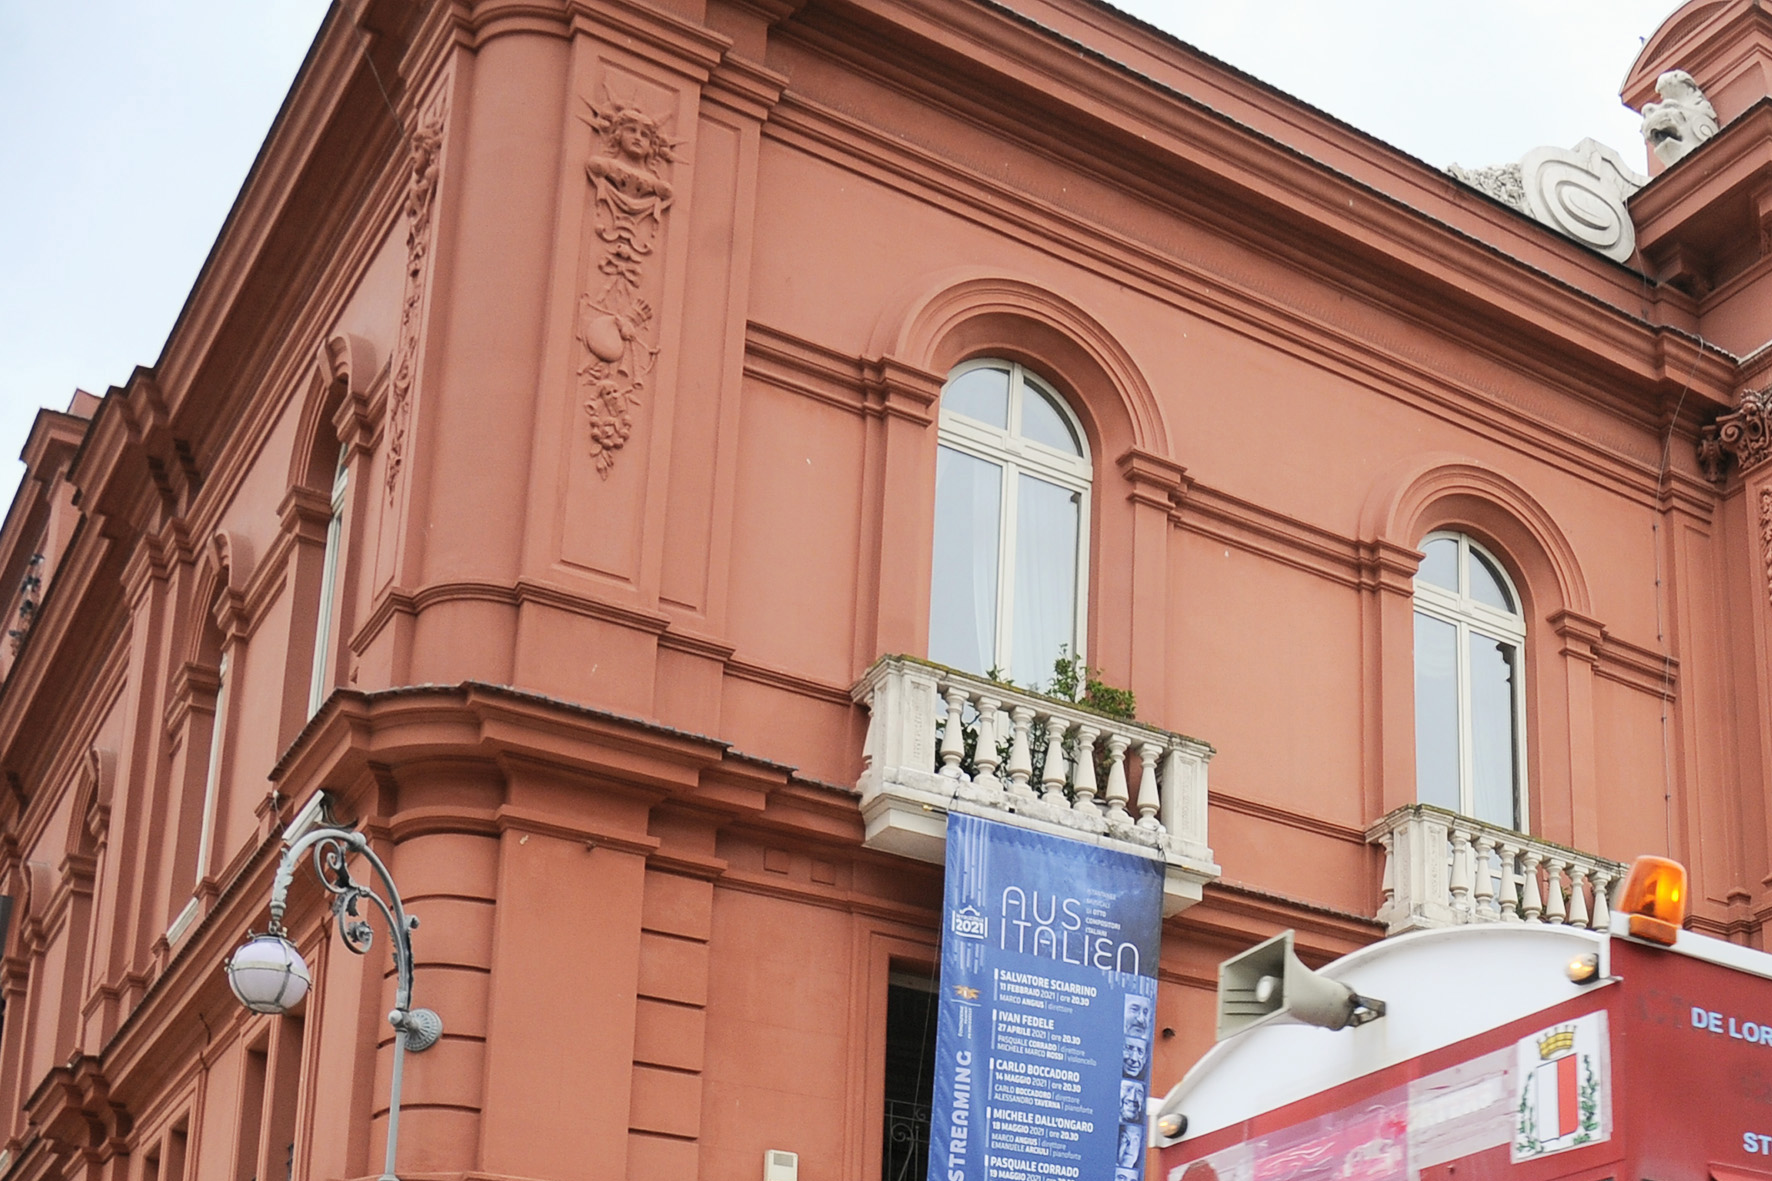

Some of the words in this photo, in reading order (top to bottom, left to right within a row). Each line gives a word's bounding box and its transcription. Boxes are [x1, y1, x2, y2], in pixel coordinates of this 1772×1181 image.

[1002, 886, 1081, 930] AUS
[956, 920, 984, 934] 2021
[1001, 918, 1139, 976] ITALIEN
[1001, 970, 1050, 988] SALVATORE
[1051, 980, 1096, 997] SCIARRINO
[1000, 994, 1021, 1004] MARCO
[1007, 984, 1040, 996] FEBBRAIO
[1041, 989, 1055, 999] 2021
[1060, 995, 1070, 1003] ore
[1071, 995, 1090, 1006] 20.30
[999, 1011, 1020, 1024] IVAN
[1022, 1014, 1054, 1030] FEDELE
[1691, 1006, 1724, 1033] DE
[998, 1023, 1006, 1032] 27
[1007, 1024, 1030, 1036] APRILE
[1032, 1030, 1046, 1039] 2021
[1062, 1035, 1080, 1045] 20.30
[998, 1035, 1028, 1046] PASQUALE
[1028, 1040, 1057, 1051] CORRADO
[997, 1043, 1023, 1054] MICHELE
[1025, 1047, 1045, 1057] MARCO
[996, 1060, 1026, 1073] CARLO
[1027, 1064, 1079, 1082] BOCCADORO
[995, 1072, 1002, 1080] 14
[1004, 1074, 1031, 1085] MAGGIO
[1032, 1078, 1047, 1087] 2021
[1052, 1082, 1062, 1090] ore
[1063, 1083, 1081, 1093] 20.30
[995, 1084, 1014, 1093] CARLO
[1015, 1087, 1051, 1099] BOCCADORO
[994, 1093, 1033, 1105] ALESSANDRO
[994, 1108, 1033, 1123] MICHELE
[1035, 1114, 1093, 1133] DALL'ONGARO
[992, 1133, 1014, 1142] MARCO
[1002, 1123, 1028, 1134] MAGGIO
[1030, 1127, 1044, 1136] 2021
[1060, 1131, 1079, 1141] 20.30
[992, 1141, 1024, 1152] EMANUELE
[991, 1156, 1037, 1172] PASQUALE
[1038, 1163, 1079, 1178] CORRADO
[999, 1170, 1026, 1181] MAGGIO
